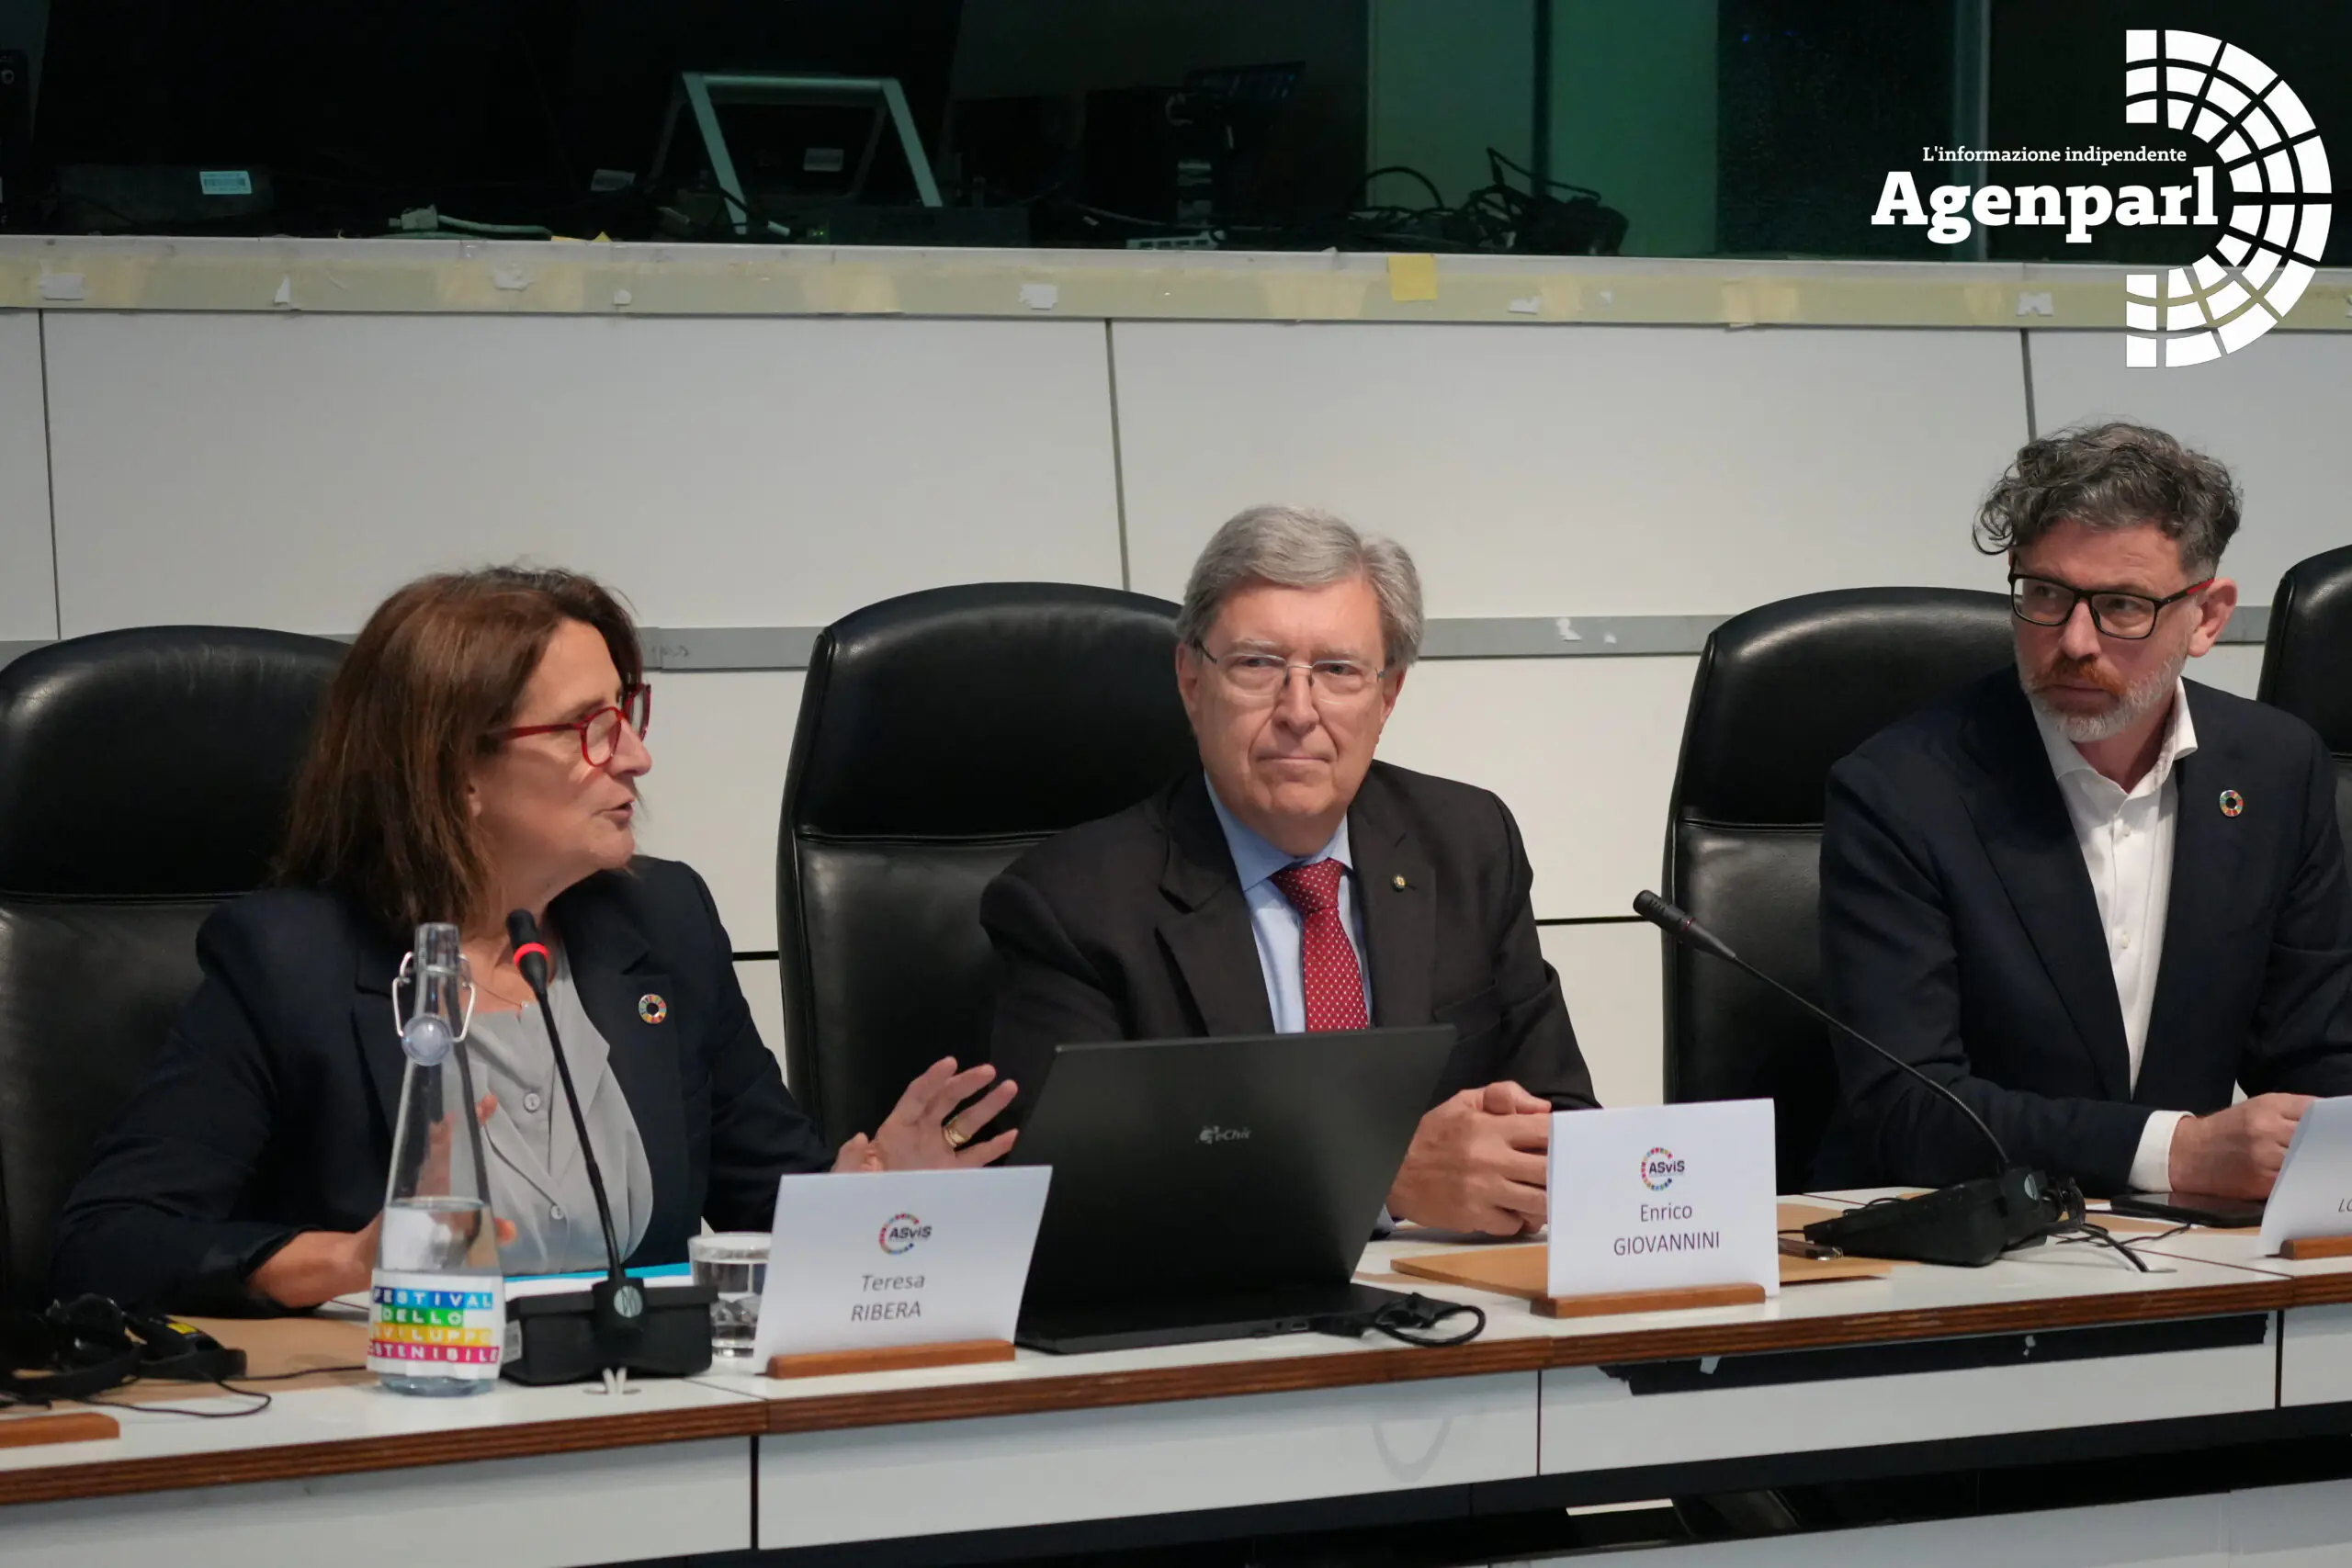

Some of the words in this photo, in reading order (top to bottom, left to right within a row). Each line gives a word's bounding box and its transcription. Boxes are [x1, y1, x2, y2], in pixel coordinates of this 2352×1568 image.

[1649, 1160, 1685, 1174] ASviS
[1640, 1202, 1692, 1223] Enrico
[889, 1225, 932, 1239] ASviS
[1613, 1231, 1720, 1257] GIOVANNINI
[862, 1274, 925, 1292] Teresa
[373, 1288, 492, 1308] FESTIVAL
[382, 1307, 462, 1325] DELLO
[851, 1301, 922, 1322] RIBERA
[369, 1342, 498, 1363] STENIBILE
